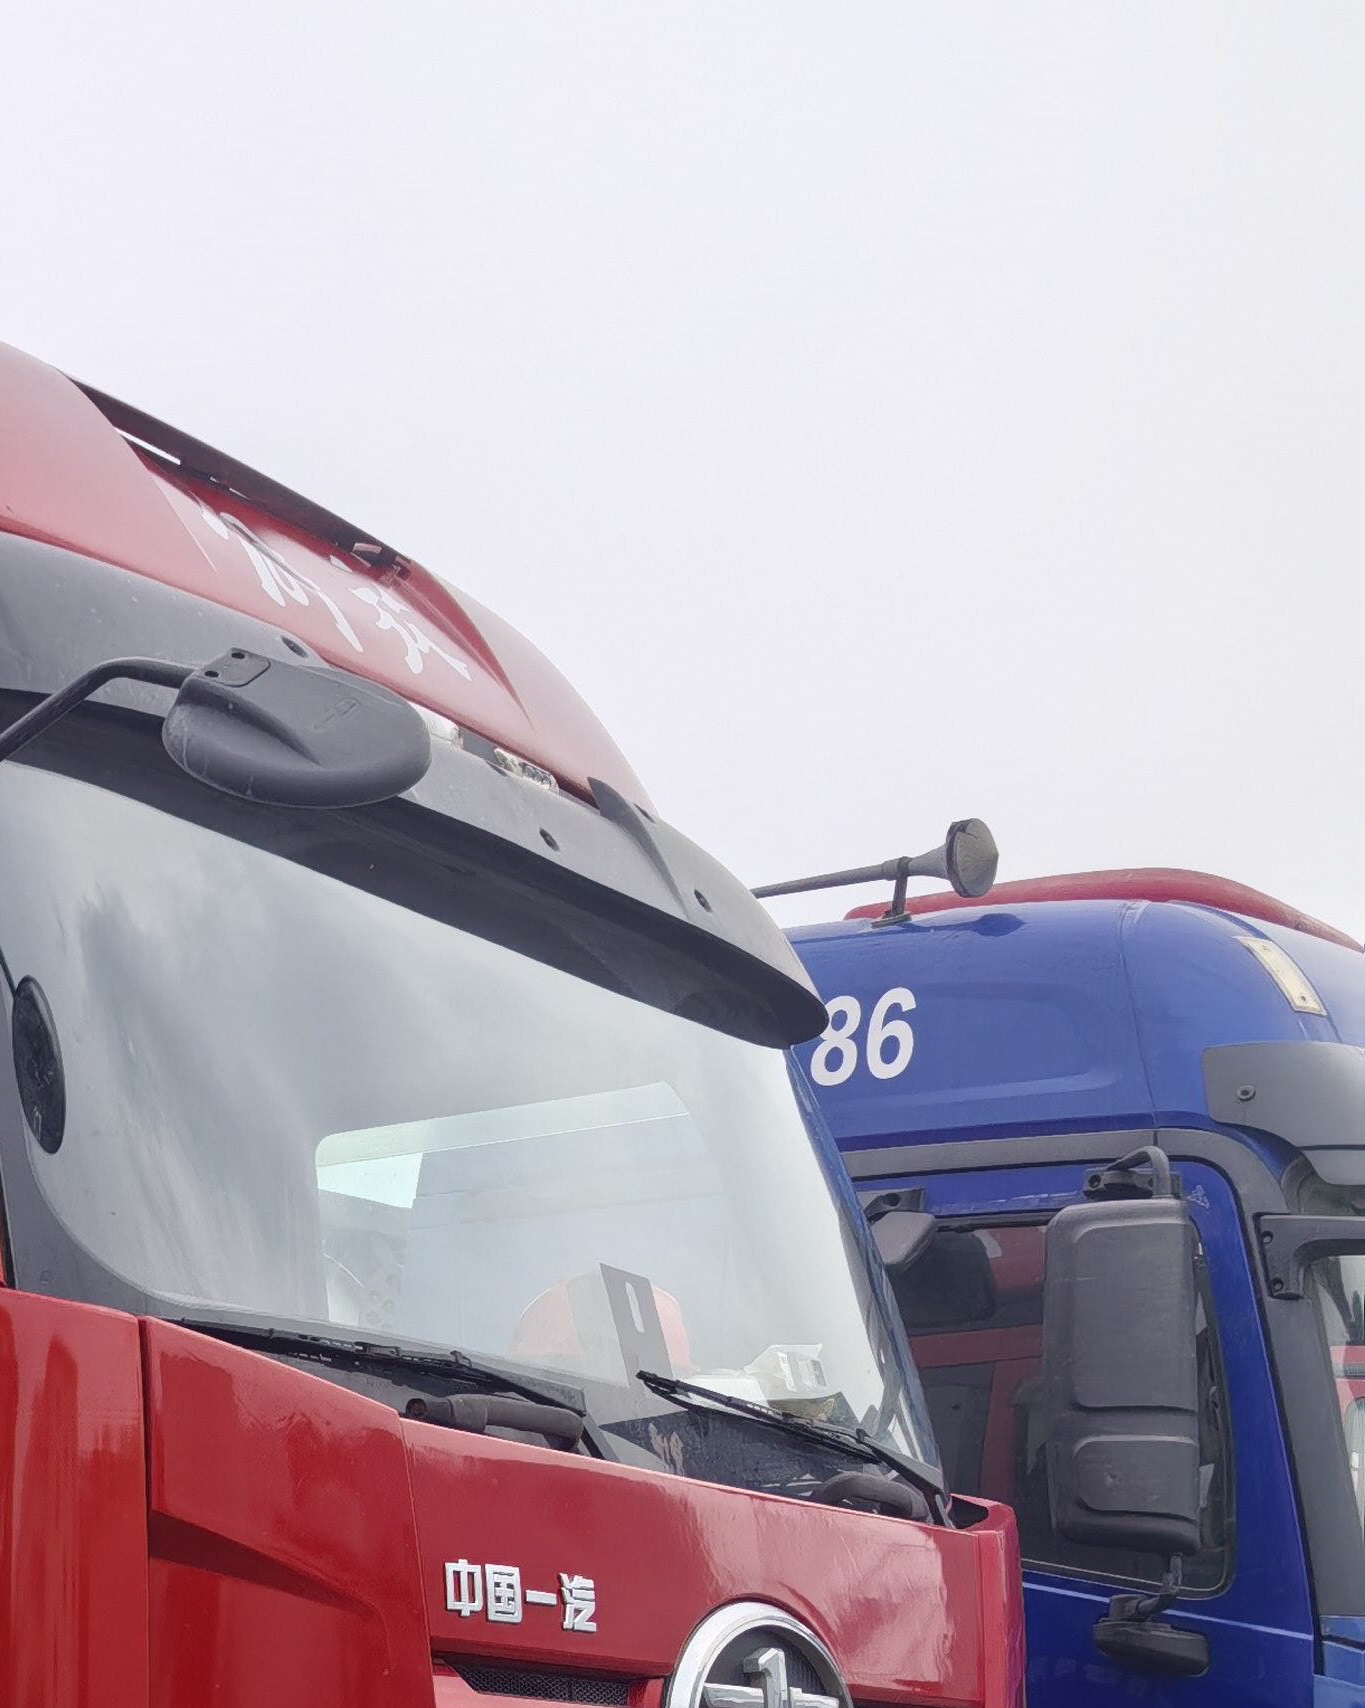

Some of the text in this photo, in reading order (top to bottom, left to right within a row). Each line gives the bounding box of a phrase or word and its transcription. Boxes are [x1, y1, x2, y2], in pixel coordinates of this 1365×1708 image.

[810, 987, 917, 1086] 86
[445, 1558, 597, 1632] 中国一汽
